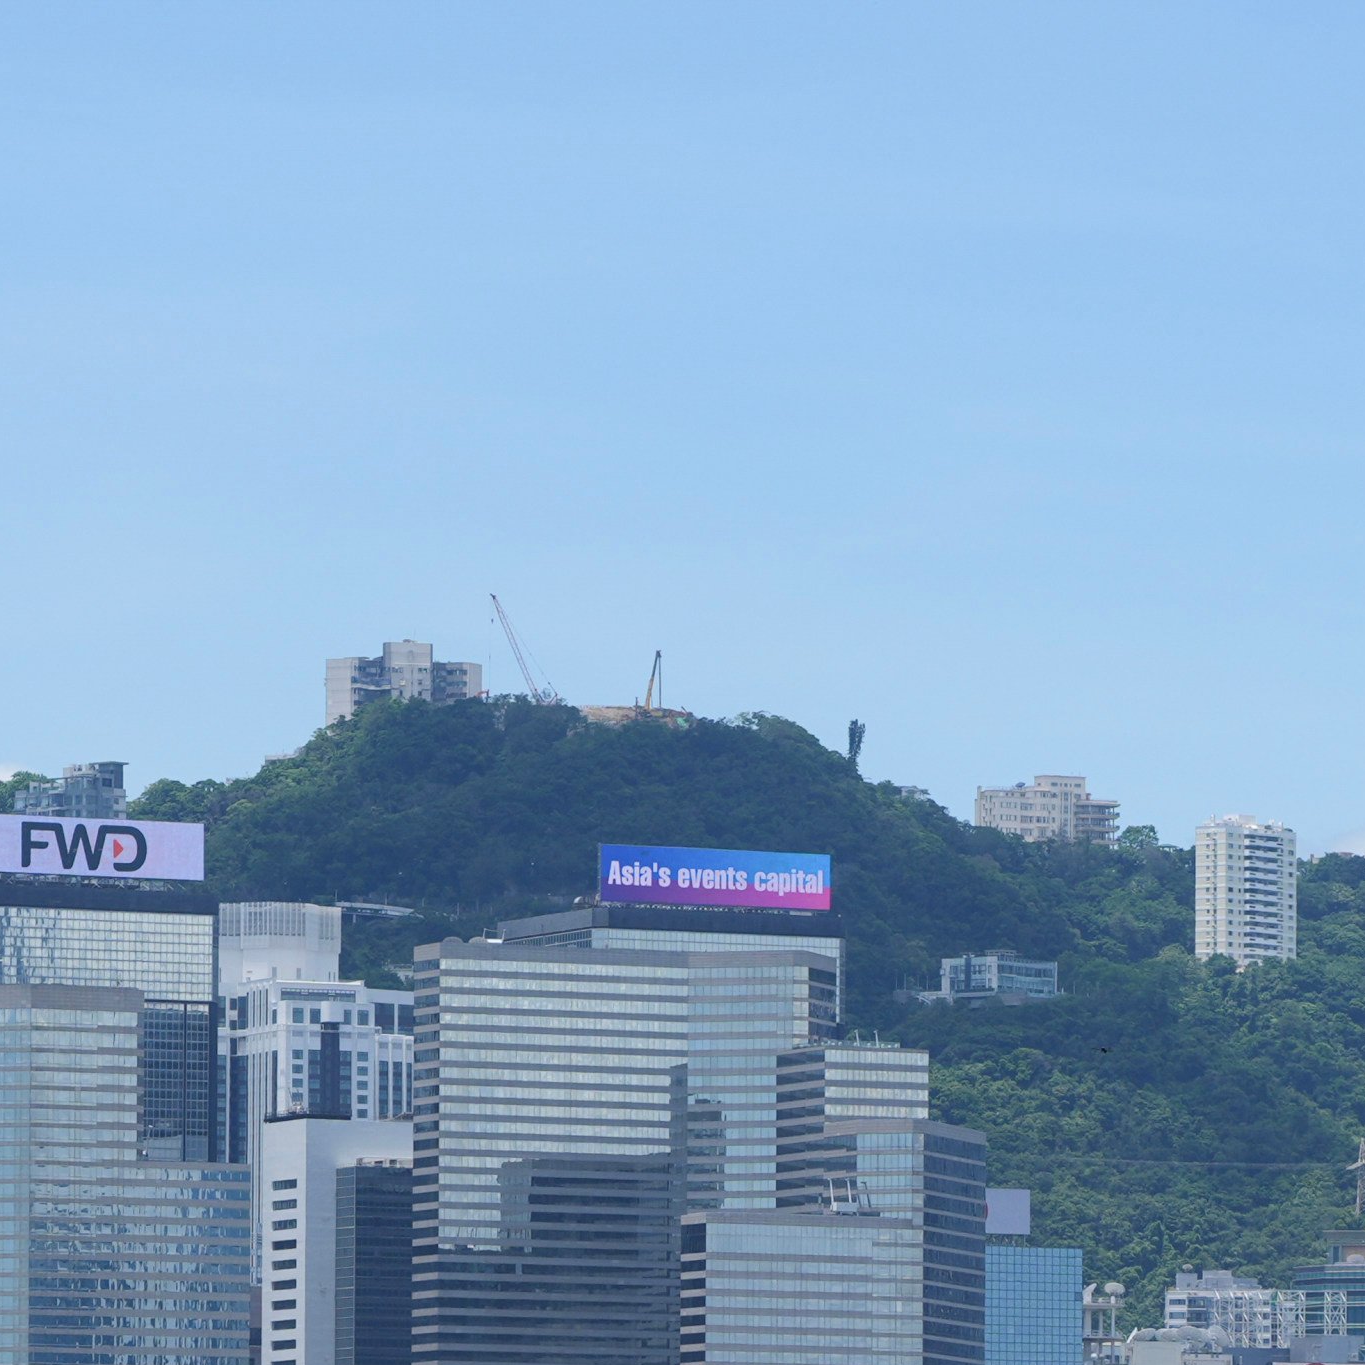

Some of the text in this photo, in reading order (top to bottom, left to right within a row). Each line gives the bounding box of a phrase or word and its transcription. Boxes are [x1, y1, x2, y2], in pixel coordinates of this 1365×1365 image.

[21, 821, 148, 872] FWD
[607, 860, 824, 896] Asia's events capital
